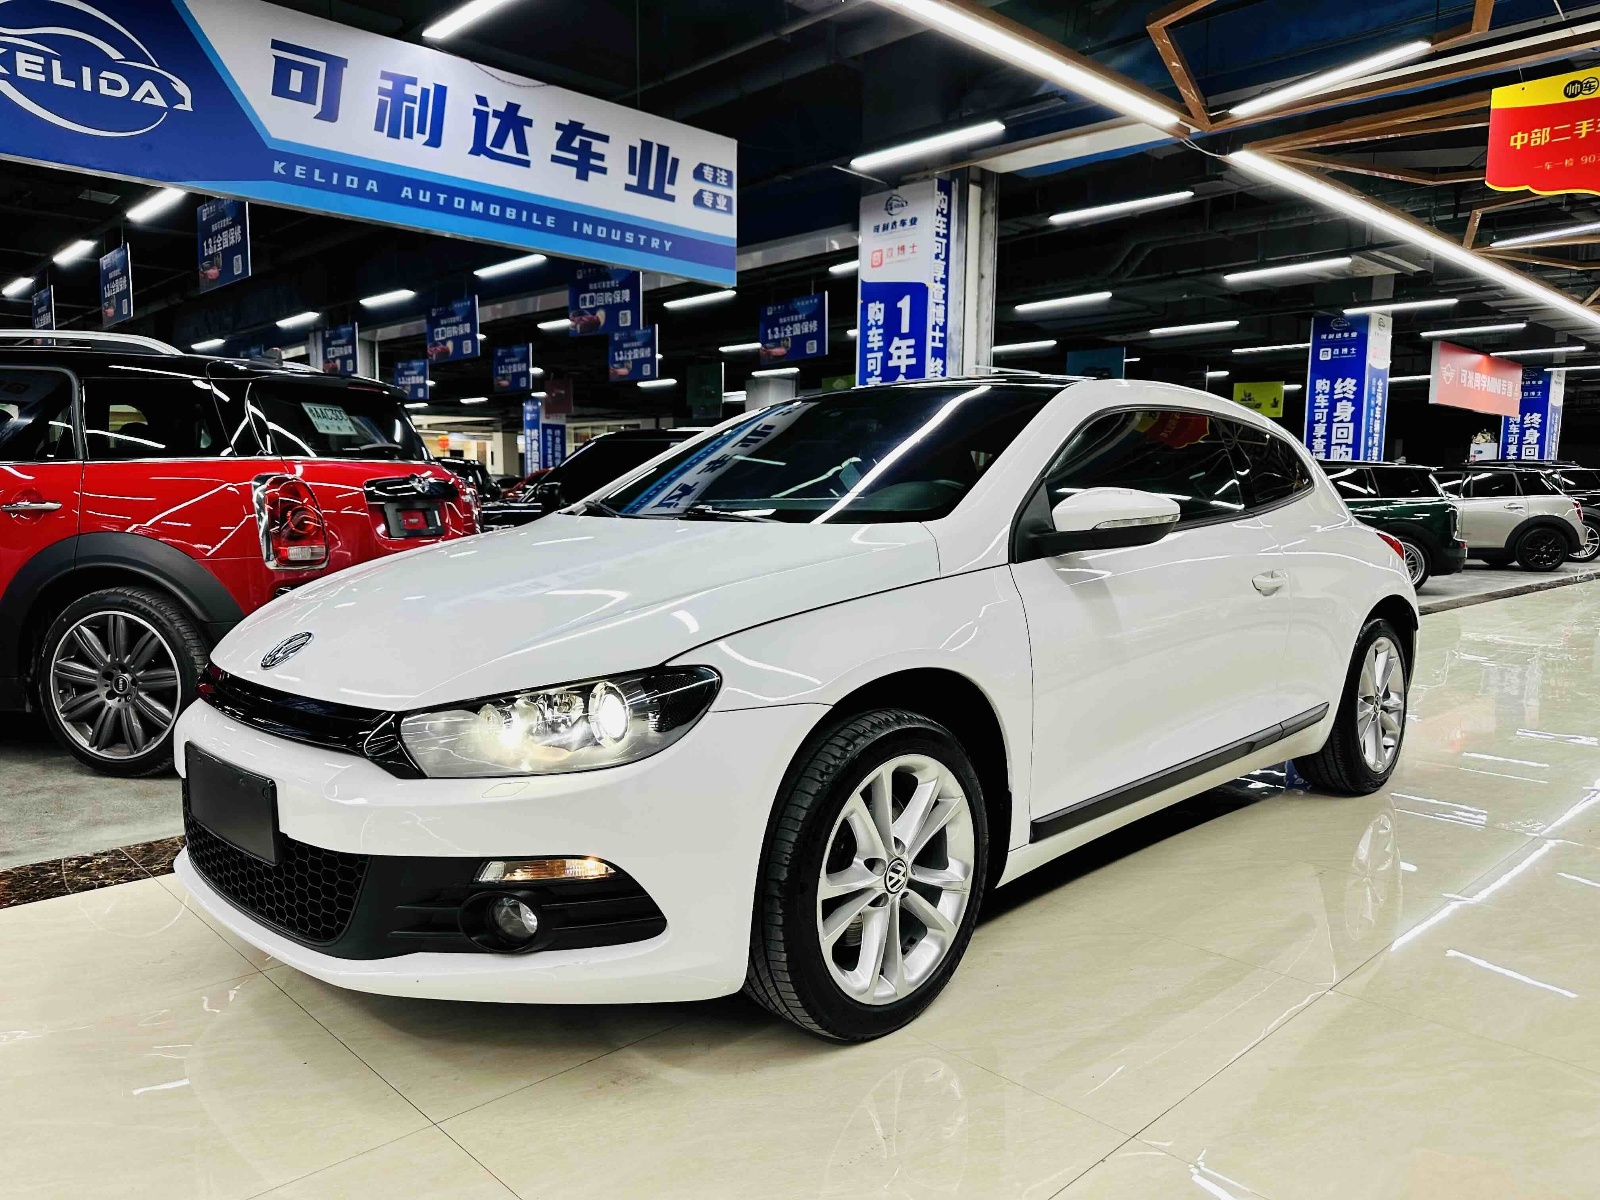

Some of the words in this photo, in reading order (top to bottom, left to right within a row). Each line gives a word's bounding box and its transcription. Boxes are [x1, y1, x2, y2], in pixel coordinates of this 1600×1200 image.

[270, 38, 680, 203] 可利达车业
[1510, 118, 1600, 150] 中部二手
[703, 164, 728, 187] 专注
[273, 160, 379, 193] KELIDA
[401, 186, 557, 228] AUTOMOBILE
[572, 220, 673, 252] INDUSTRY
[702, 190, 728, 211] 专业
